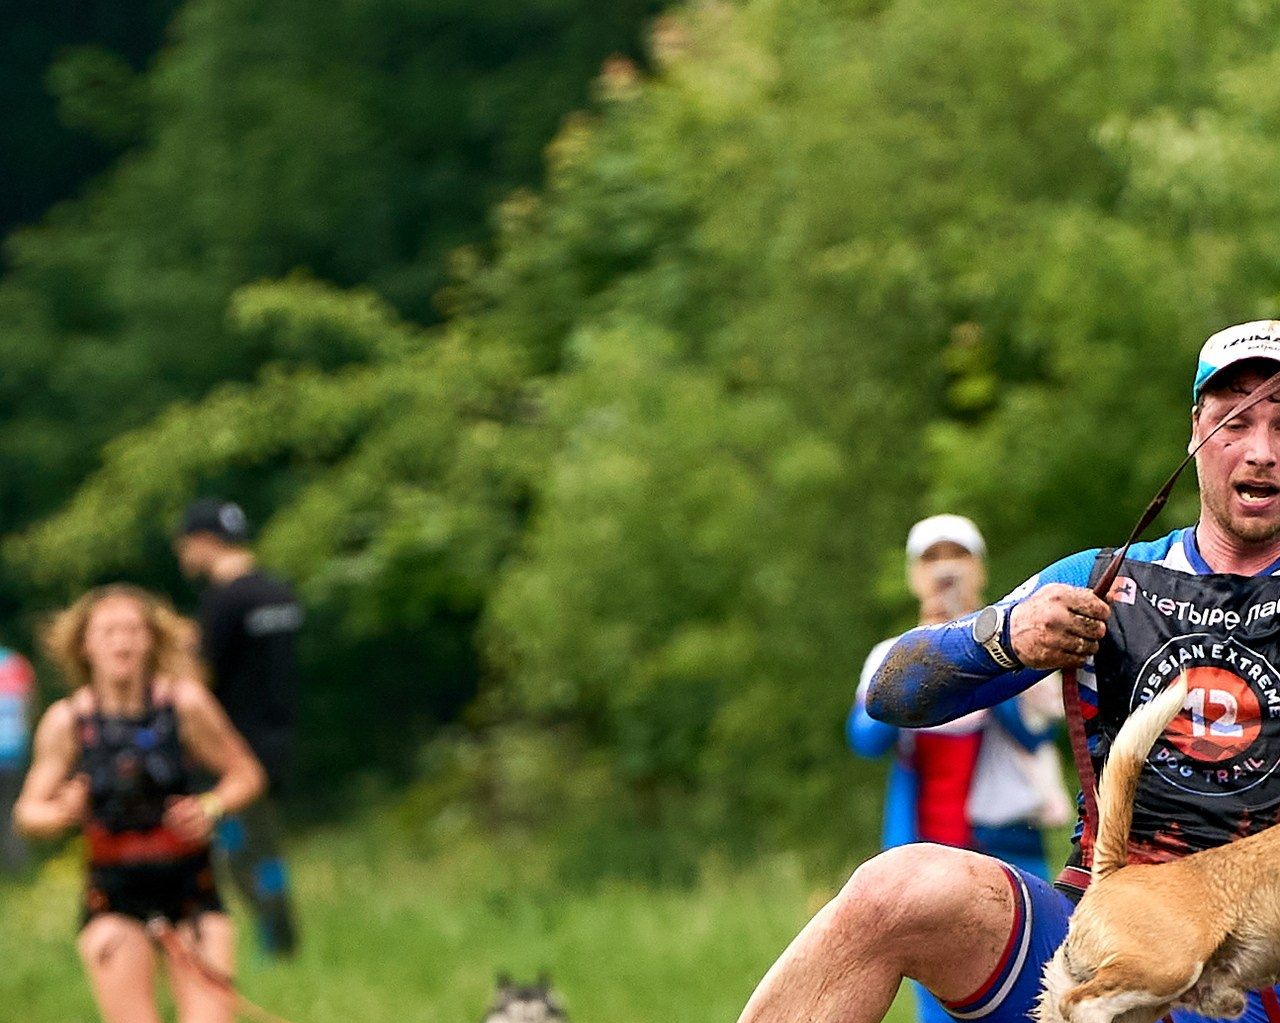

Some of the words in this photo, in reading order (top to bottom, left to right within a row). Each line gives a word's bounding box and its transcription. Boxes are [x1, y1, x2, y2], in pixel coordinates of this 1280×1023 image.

[1142, 590, 1241, 630] четыре
[1139, 644, 1205, 703] USSIAN
[1183, 687, 1244, 737] 12
[1155, 747, 1194, 778] DOG
[1202, 757, 1265, 783] TRAIL
